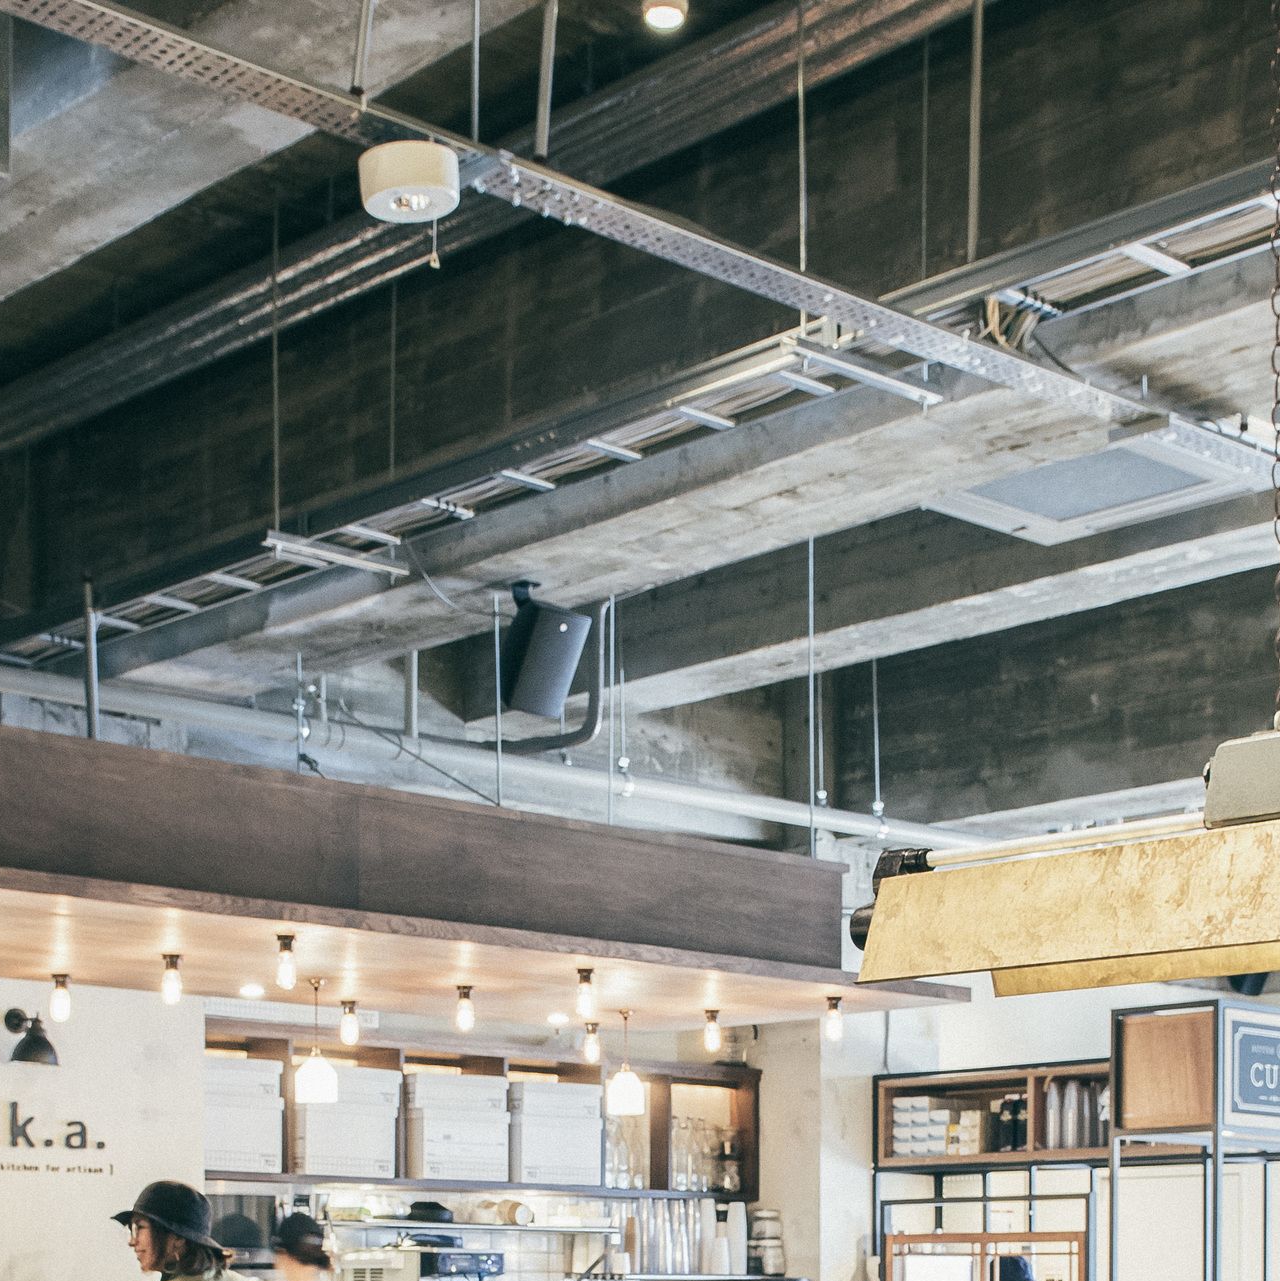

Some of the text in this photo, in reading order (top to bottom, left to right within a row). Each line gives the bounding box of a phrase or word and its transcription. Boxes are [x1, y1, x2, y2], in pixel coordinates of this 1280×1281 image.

[0, 1161, 40, 1172] kitchen
[46, 1163, 61, 1173] for
[66, 1164, 104, 1174] artisan
